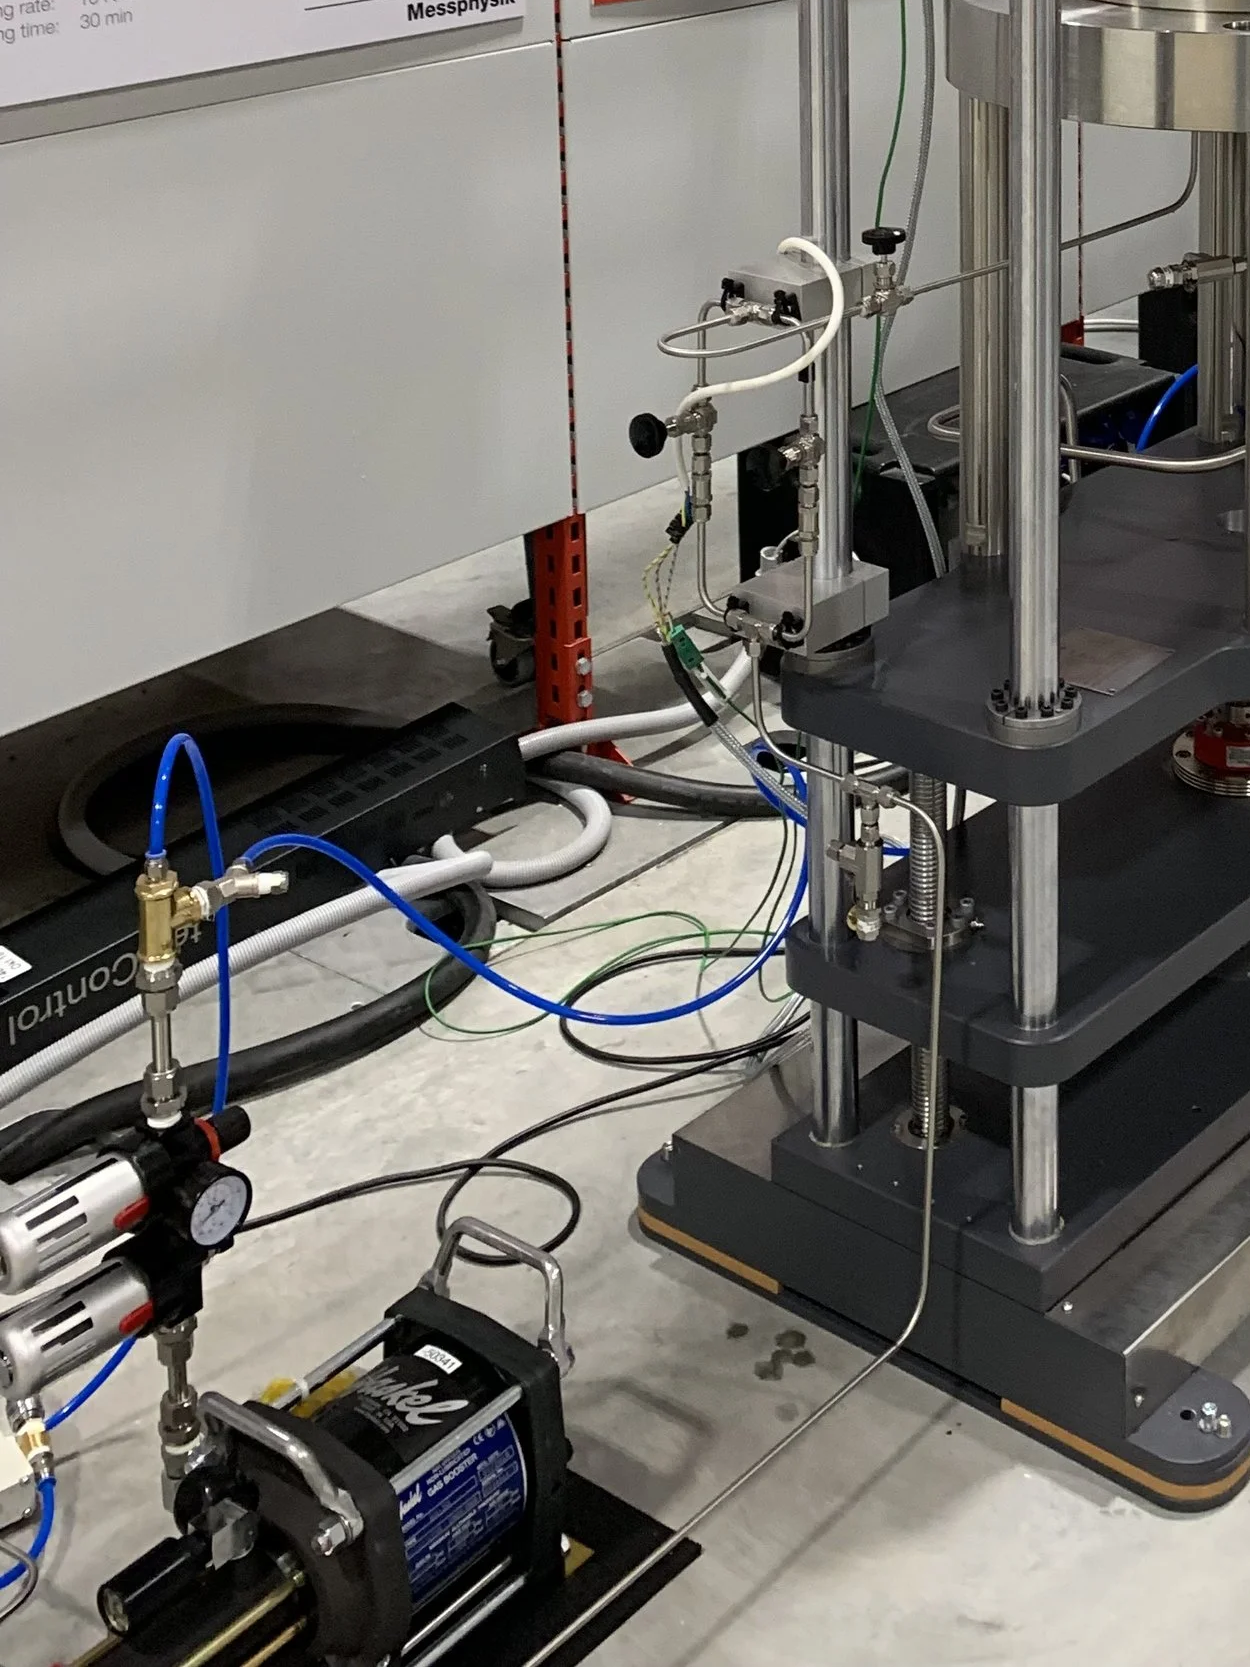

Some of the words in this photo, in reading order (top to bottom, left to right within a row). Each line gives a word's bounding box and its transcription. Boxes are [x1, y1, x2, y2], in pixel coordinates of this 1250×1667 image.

[20, 21, 60, 39] time:
[80, 12, 101, 30] 30
[105, 8, 133, 26] min
